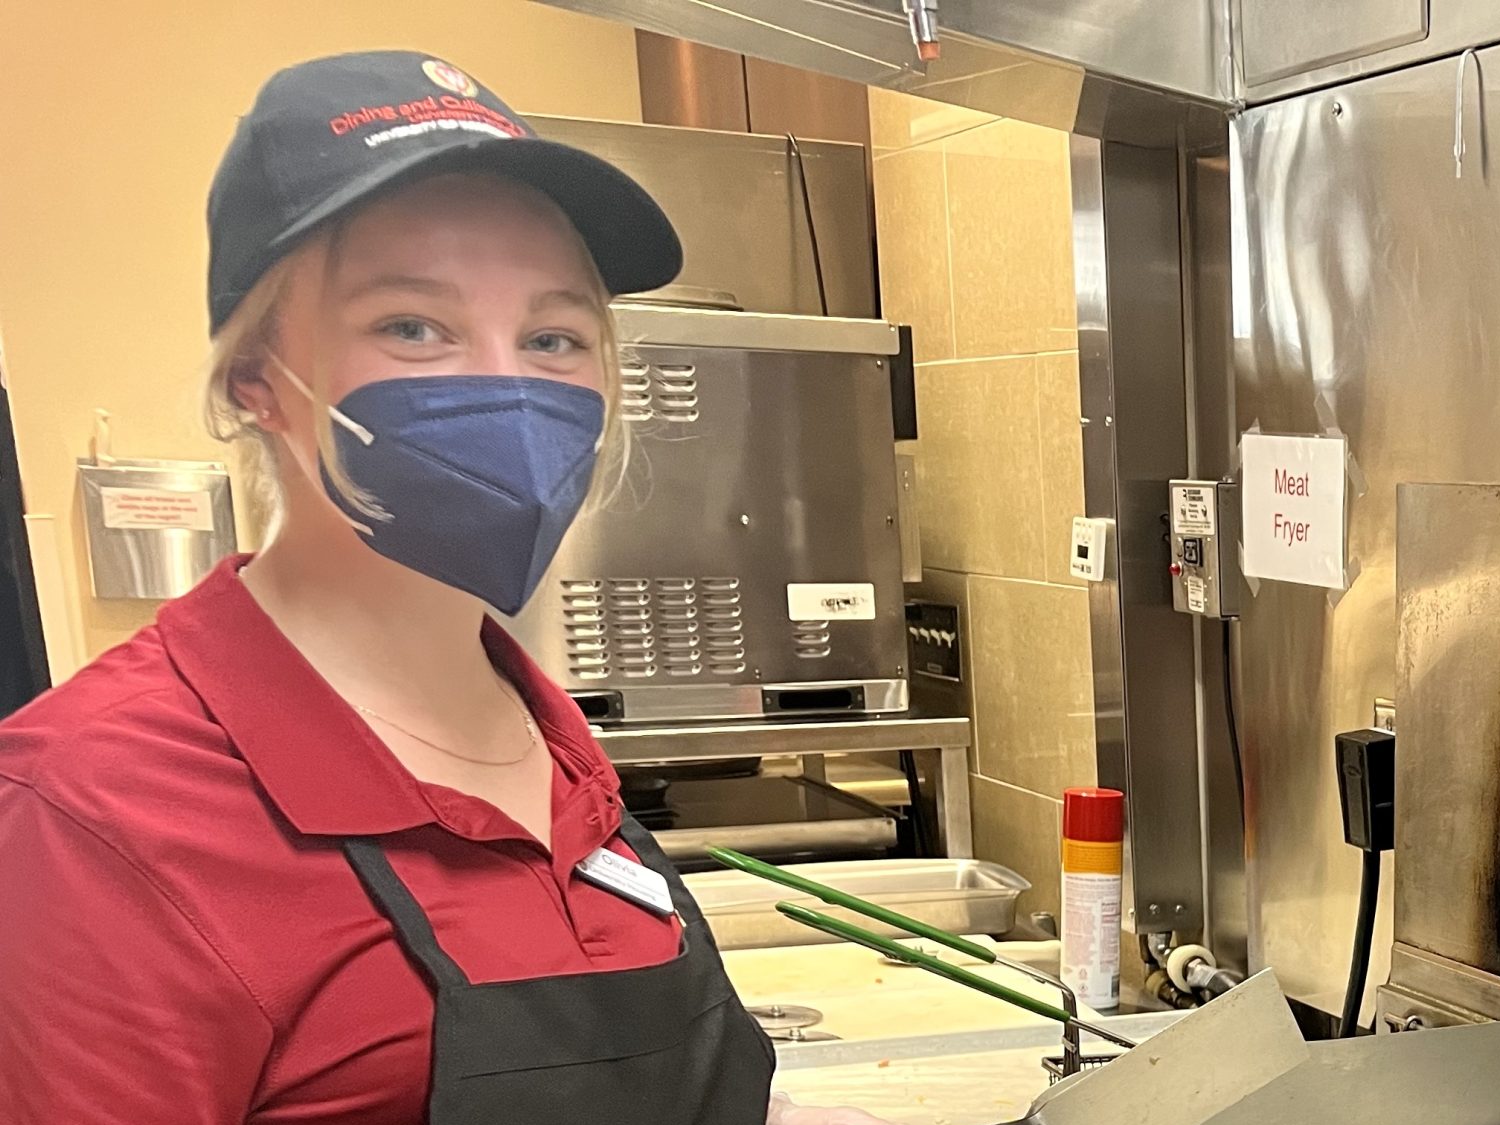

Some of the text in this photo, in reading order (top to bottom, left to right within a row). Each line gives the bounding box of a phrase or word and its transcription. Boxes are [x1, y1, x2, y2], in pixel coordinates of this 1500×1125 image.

[329, 106, 398, 136] Dining
[399, 95, 438, 116] and
[1274, 467, 1310, 497] Meat
[1273, 513, 1311, 547] Fryer
